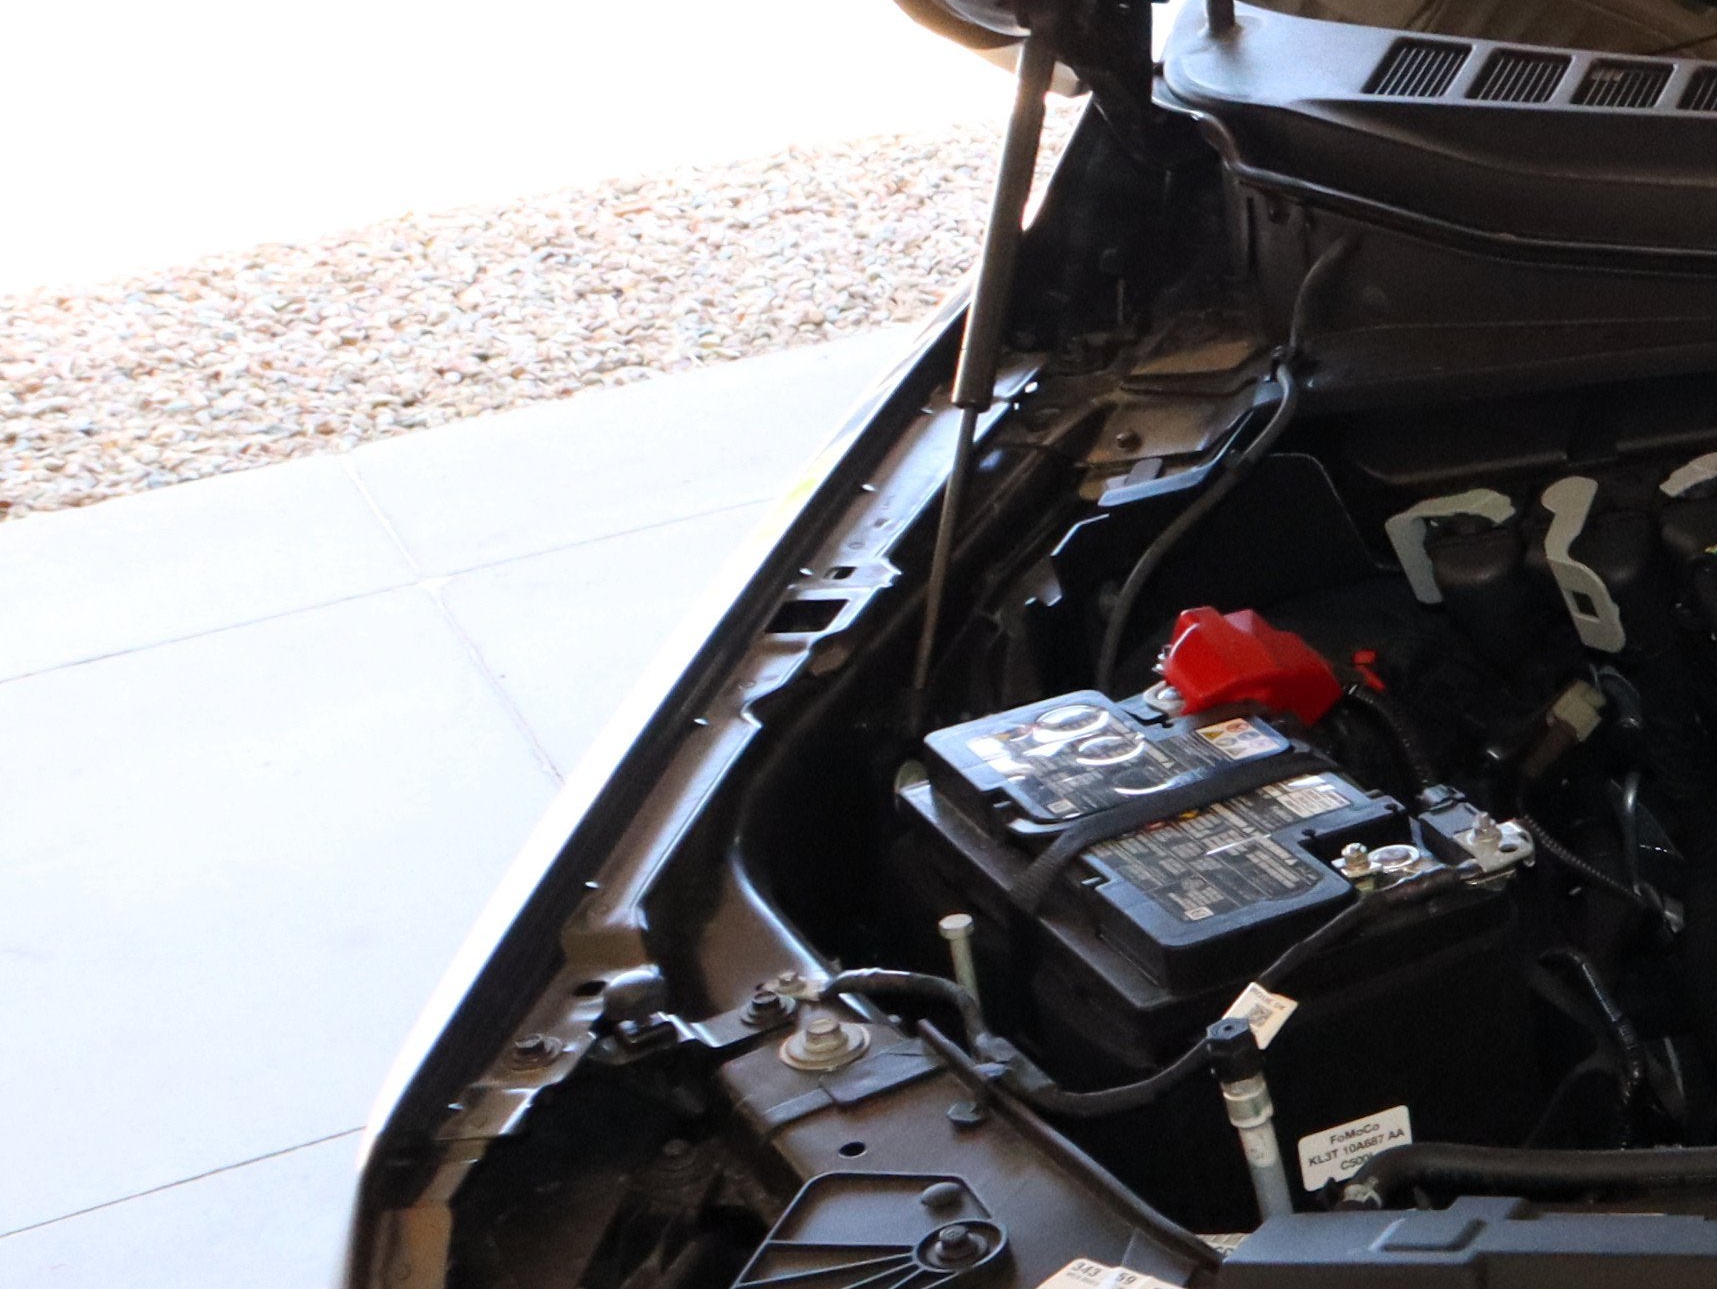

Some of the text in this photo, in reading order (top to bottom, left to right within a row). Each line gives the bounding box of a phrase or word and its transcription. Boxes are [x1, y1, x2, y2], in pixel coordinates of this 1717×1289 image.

[1307, 1149, 1339, 1167] KL3T
[1387, 1127, 1405, 1141] AA
[1329, 1122, 1381, 1145] FoMoCo
